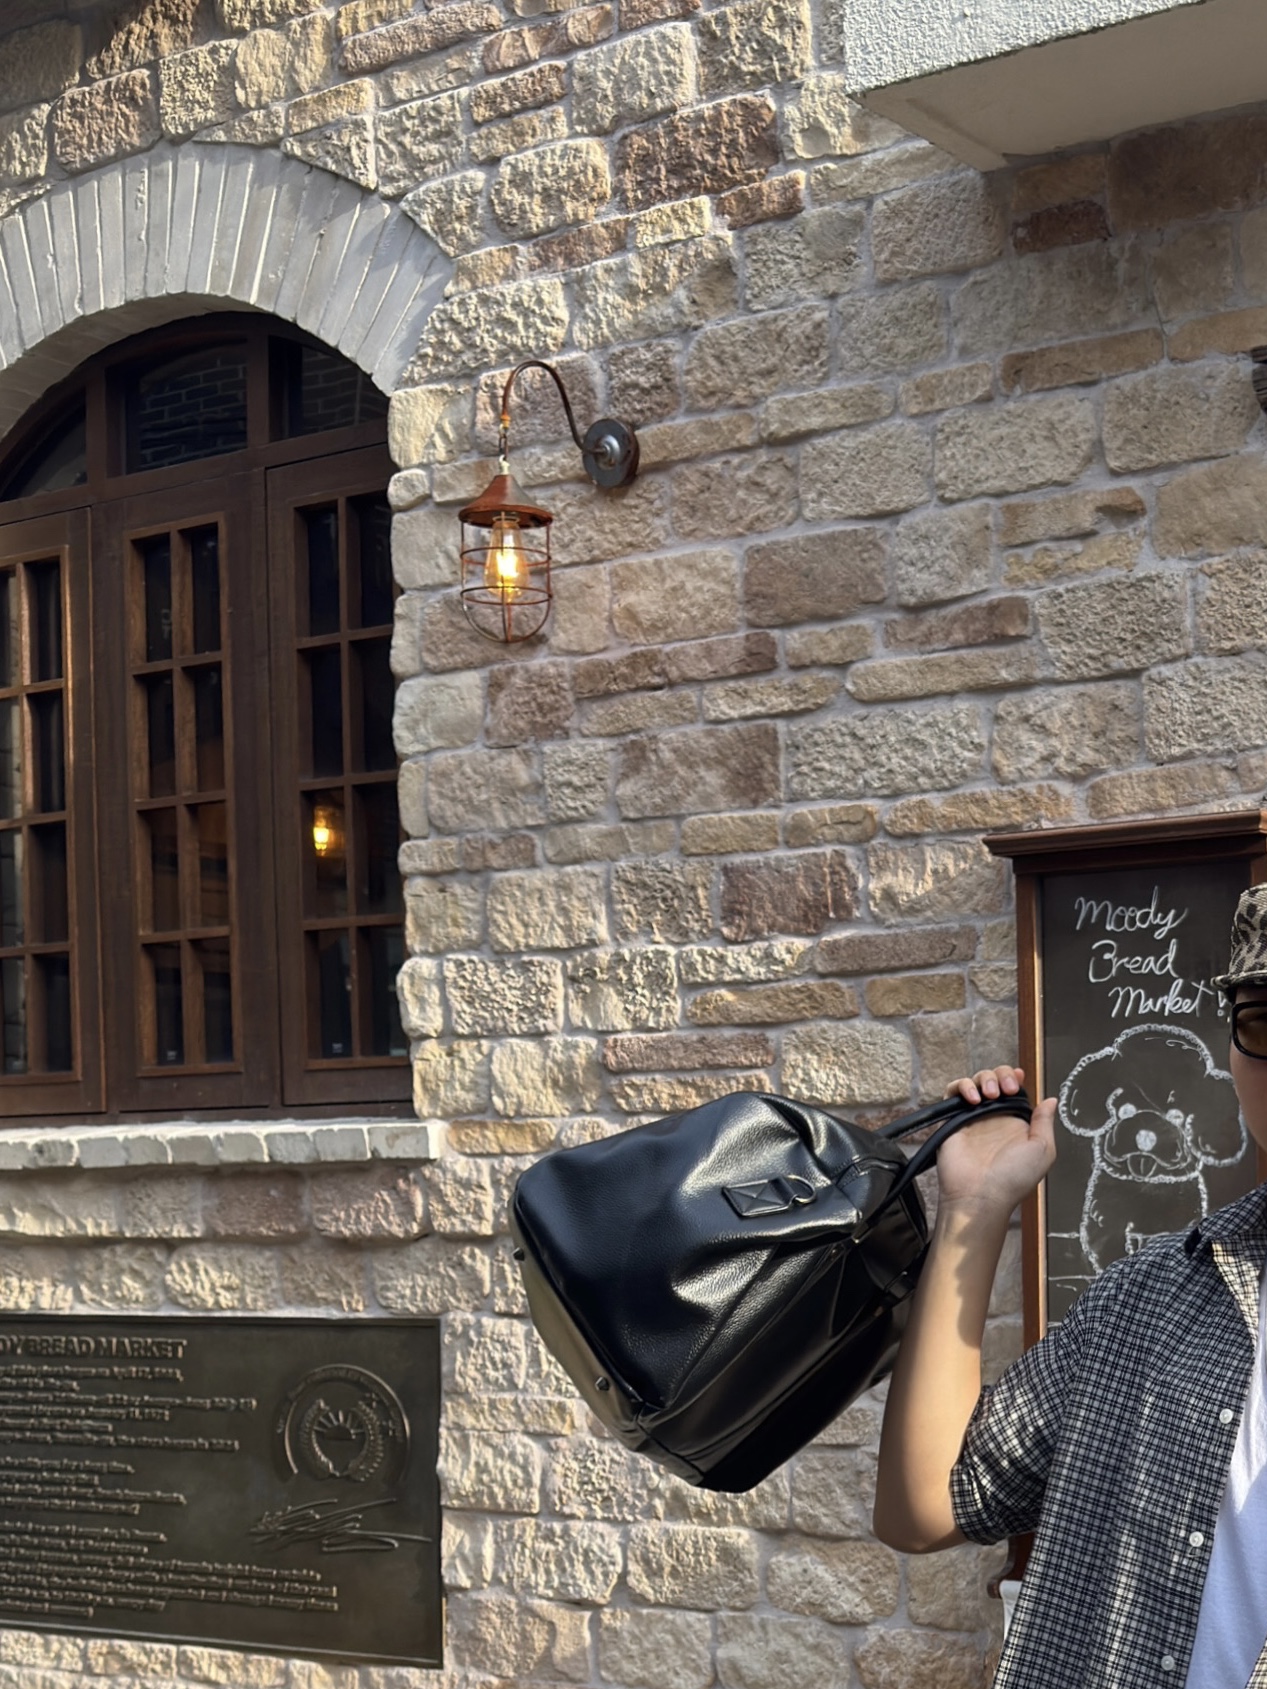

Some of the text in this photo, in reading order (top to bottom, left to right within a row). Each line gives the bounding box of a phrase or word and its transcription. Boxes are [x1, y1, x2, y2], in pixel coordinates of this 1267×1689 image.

[1075, 885, 1188, 940] Moody
[1088, 938, 1179, 983] Bread
[29, 1335, 96, 1357] BREAD
[99, 1336, 188, 1360] MARKET
